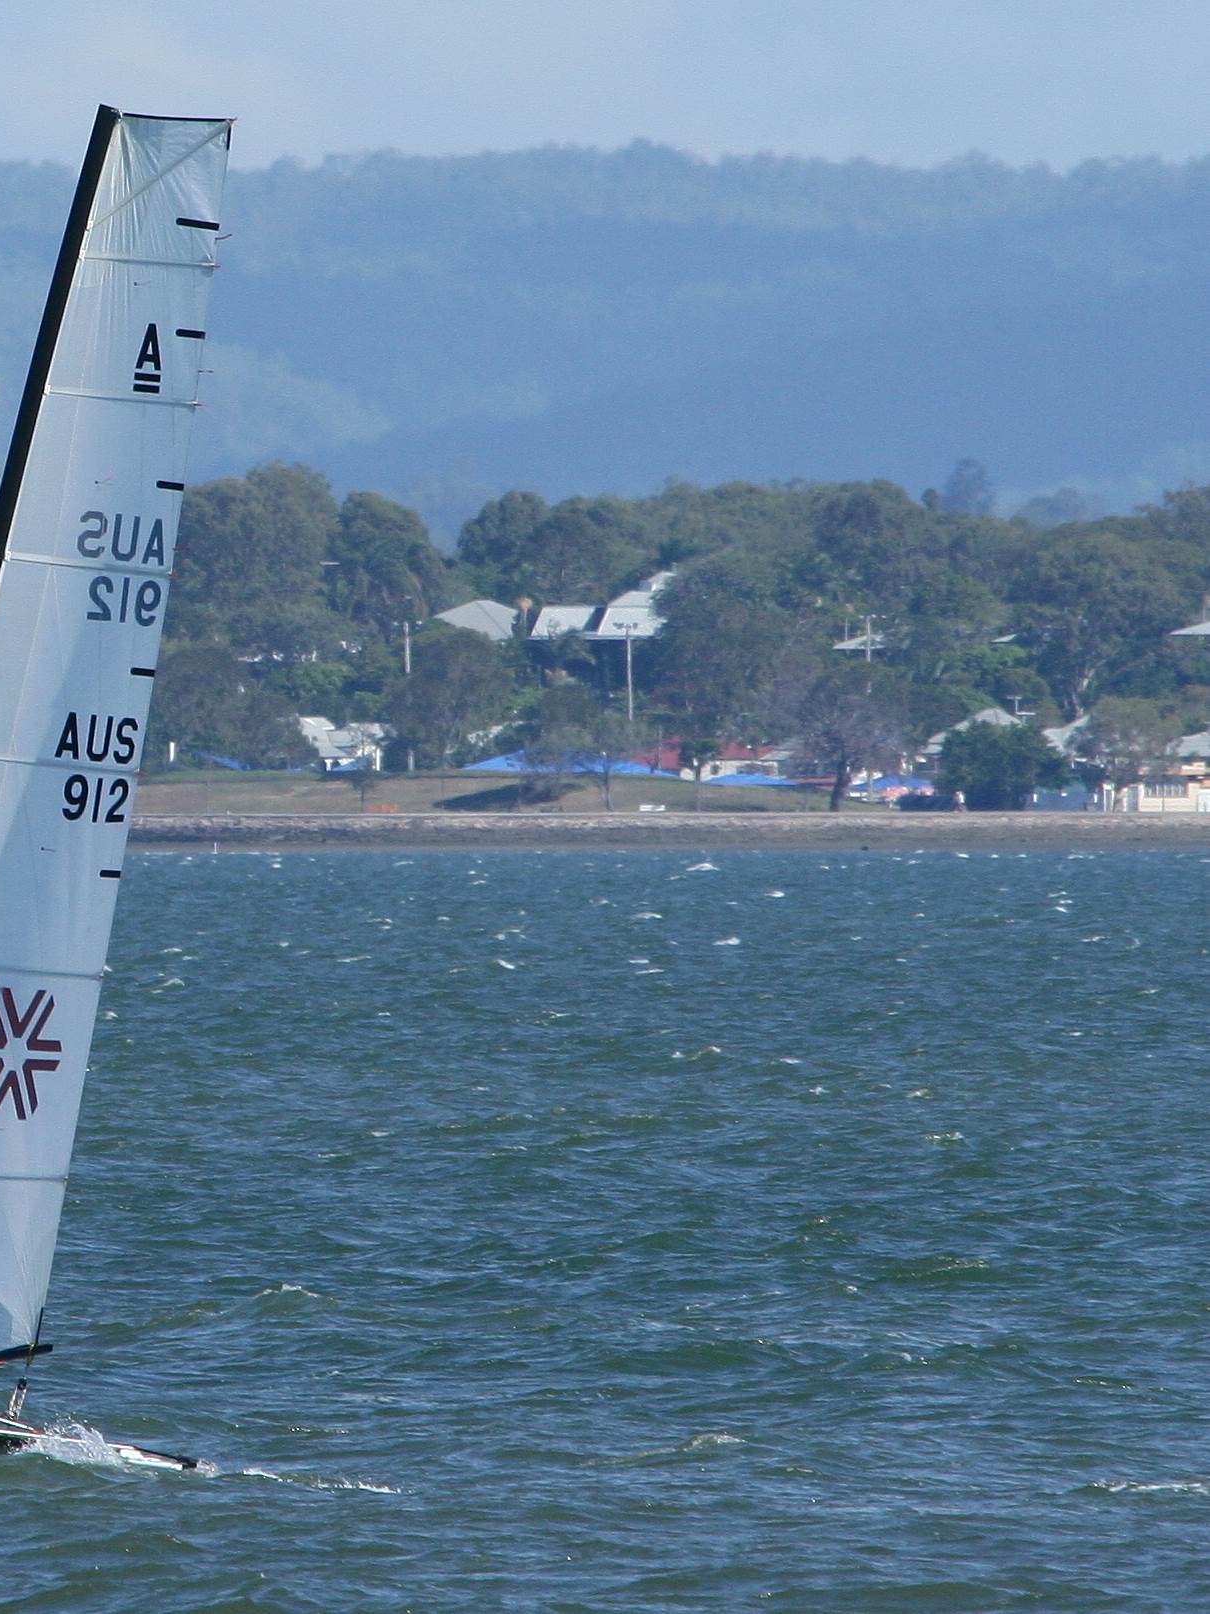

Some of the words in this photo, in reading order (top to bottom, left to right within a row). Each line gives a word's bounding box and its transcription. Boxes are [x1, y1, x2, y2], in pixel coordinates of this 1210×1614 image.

[135, 322, 162, 371] A
[54, 712, 139, 764] AUS
[62, 774, 130, 823] 912
